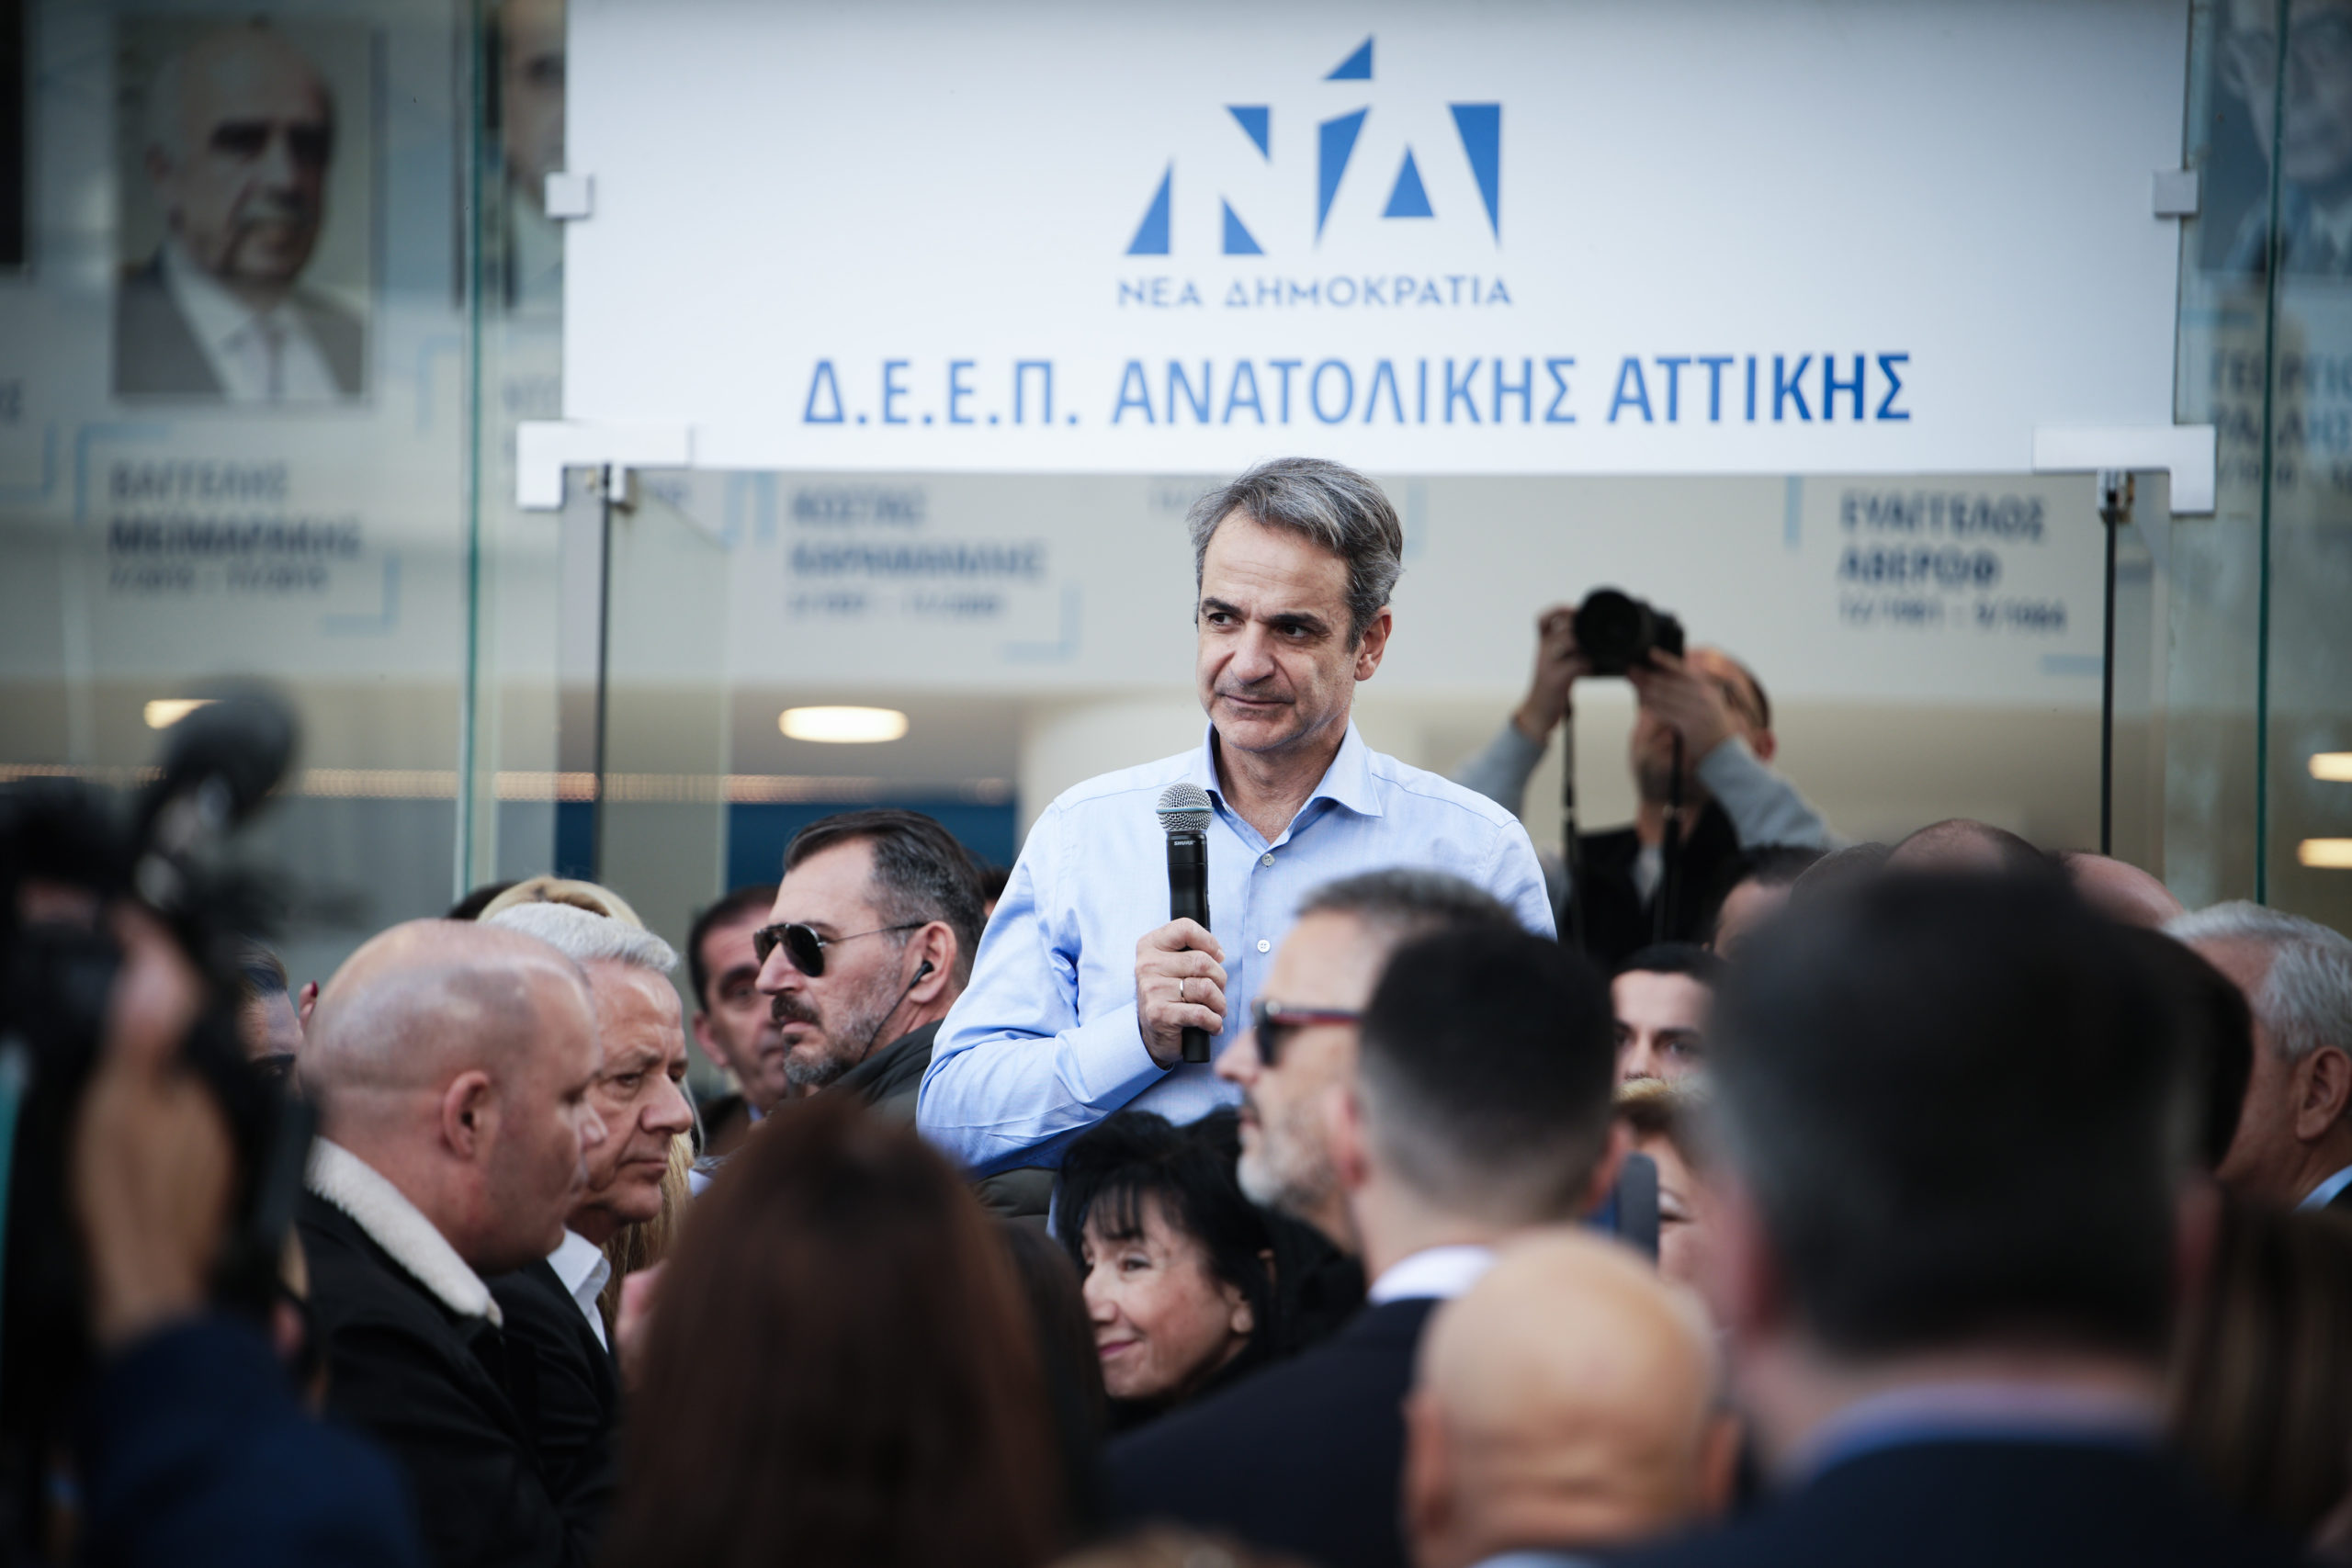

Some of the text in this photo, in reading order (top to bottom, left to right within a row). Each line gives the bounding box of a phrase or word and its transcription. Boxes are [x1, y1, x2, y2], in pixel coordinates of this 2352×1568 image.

[1117, 275, 1512, 308] ΝΕΑ ΔΗΜΟΚΡΑΤΙΑ
[801, 350, 1912, 426] Δ.Ε.Ε.Π. ΑΝΑΤΟΛΙΚΗΣ ΑΤΤΙΚΗΣ
